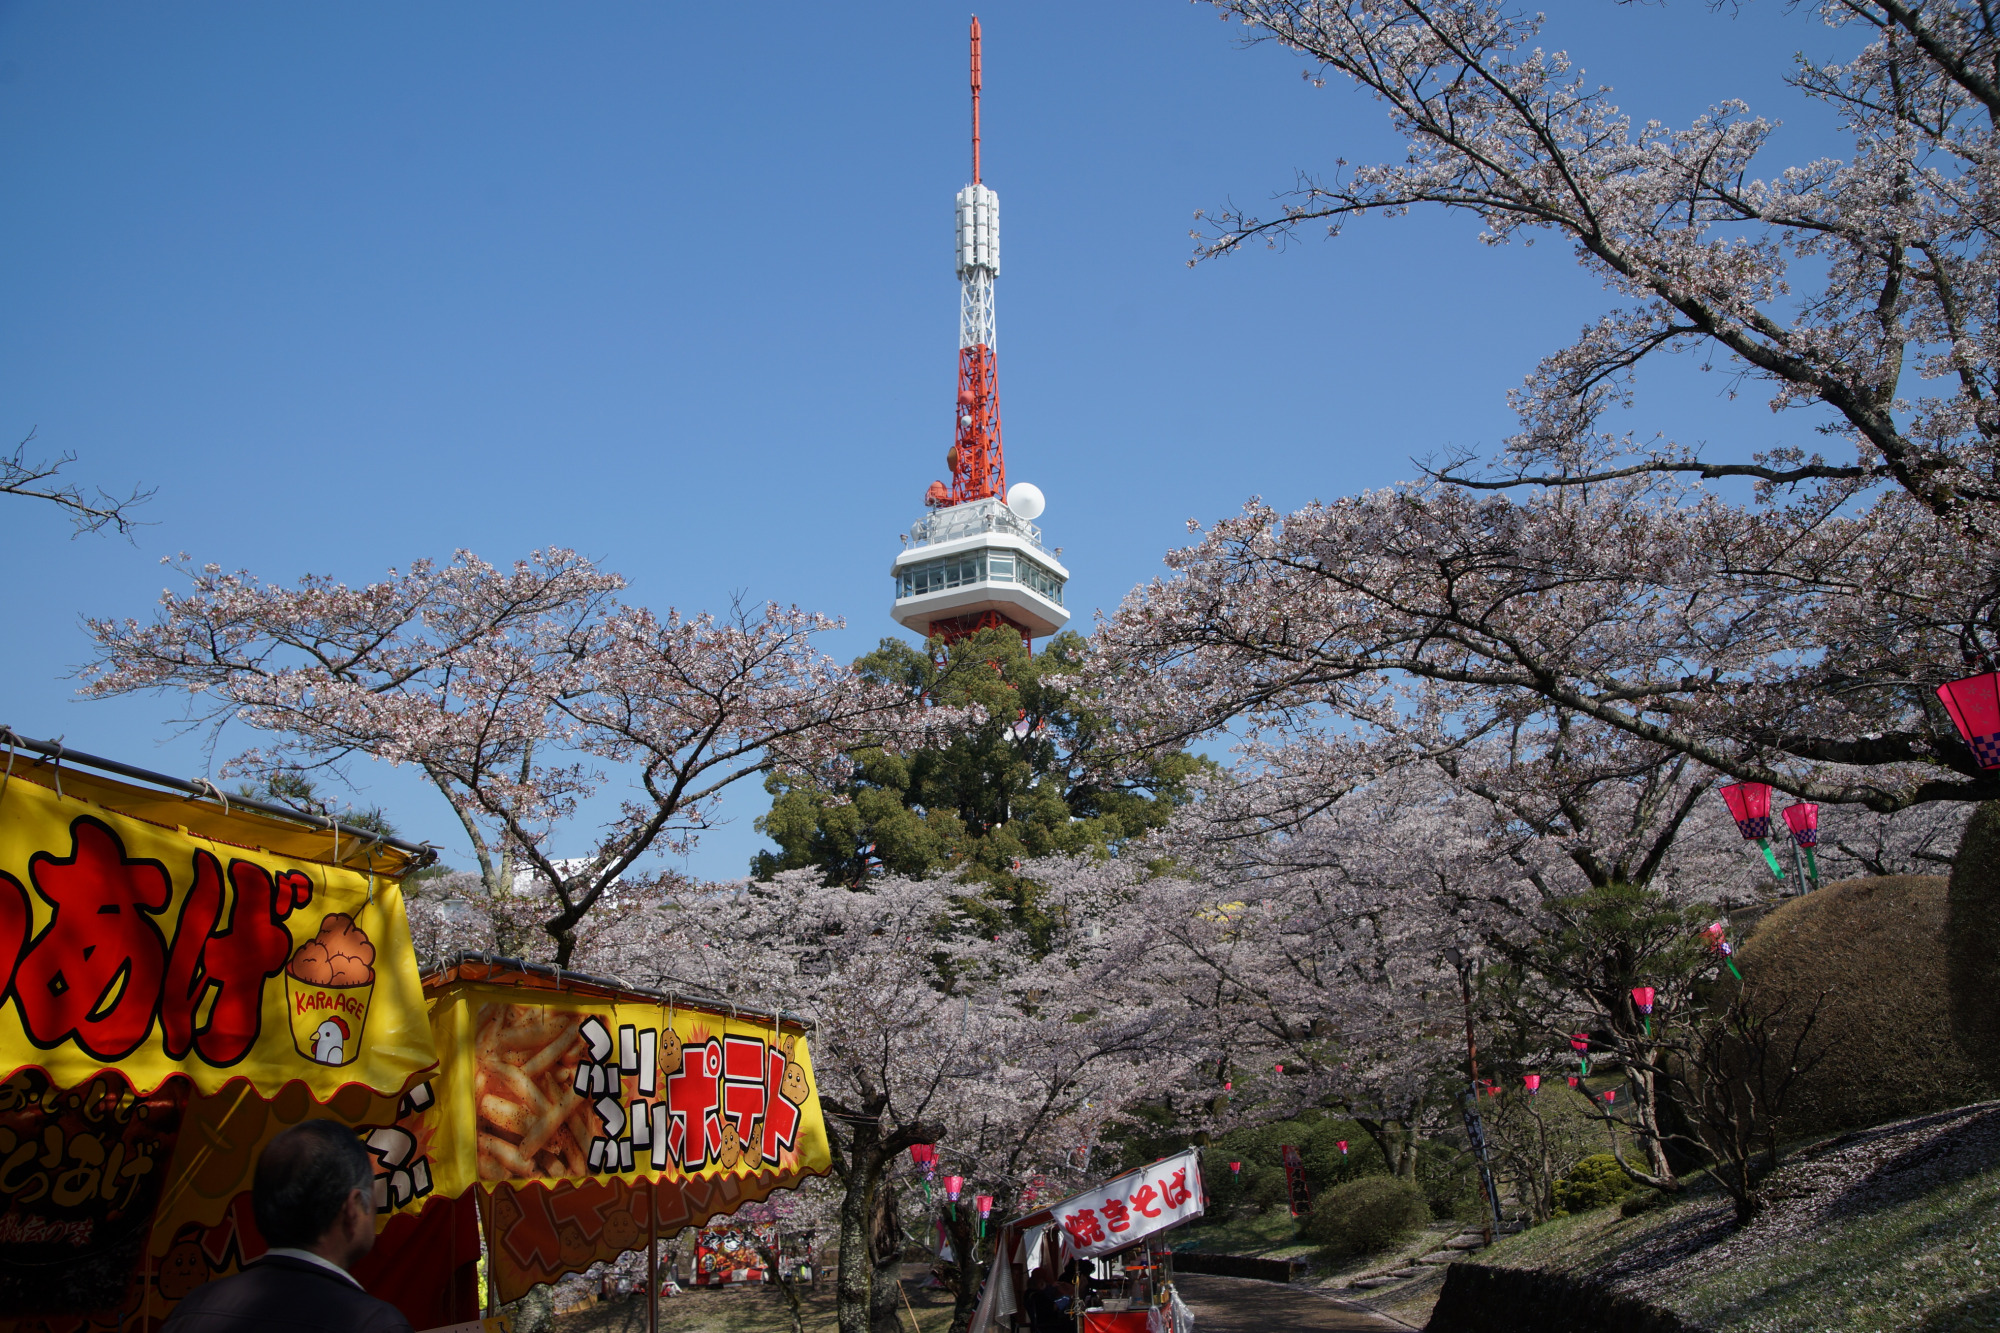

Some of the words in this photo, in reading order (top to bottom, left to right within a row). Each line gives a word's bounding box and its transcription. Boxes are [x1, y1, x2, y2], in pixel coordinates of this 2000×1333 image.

[0, 814, 313, 1068] あげ
[295, 990, 365, 1020] KARAAGE
[0, 1124, 160, 1211] らあげ
[1064, 1167, 1193, 1249] 焼きそば
